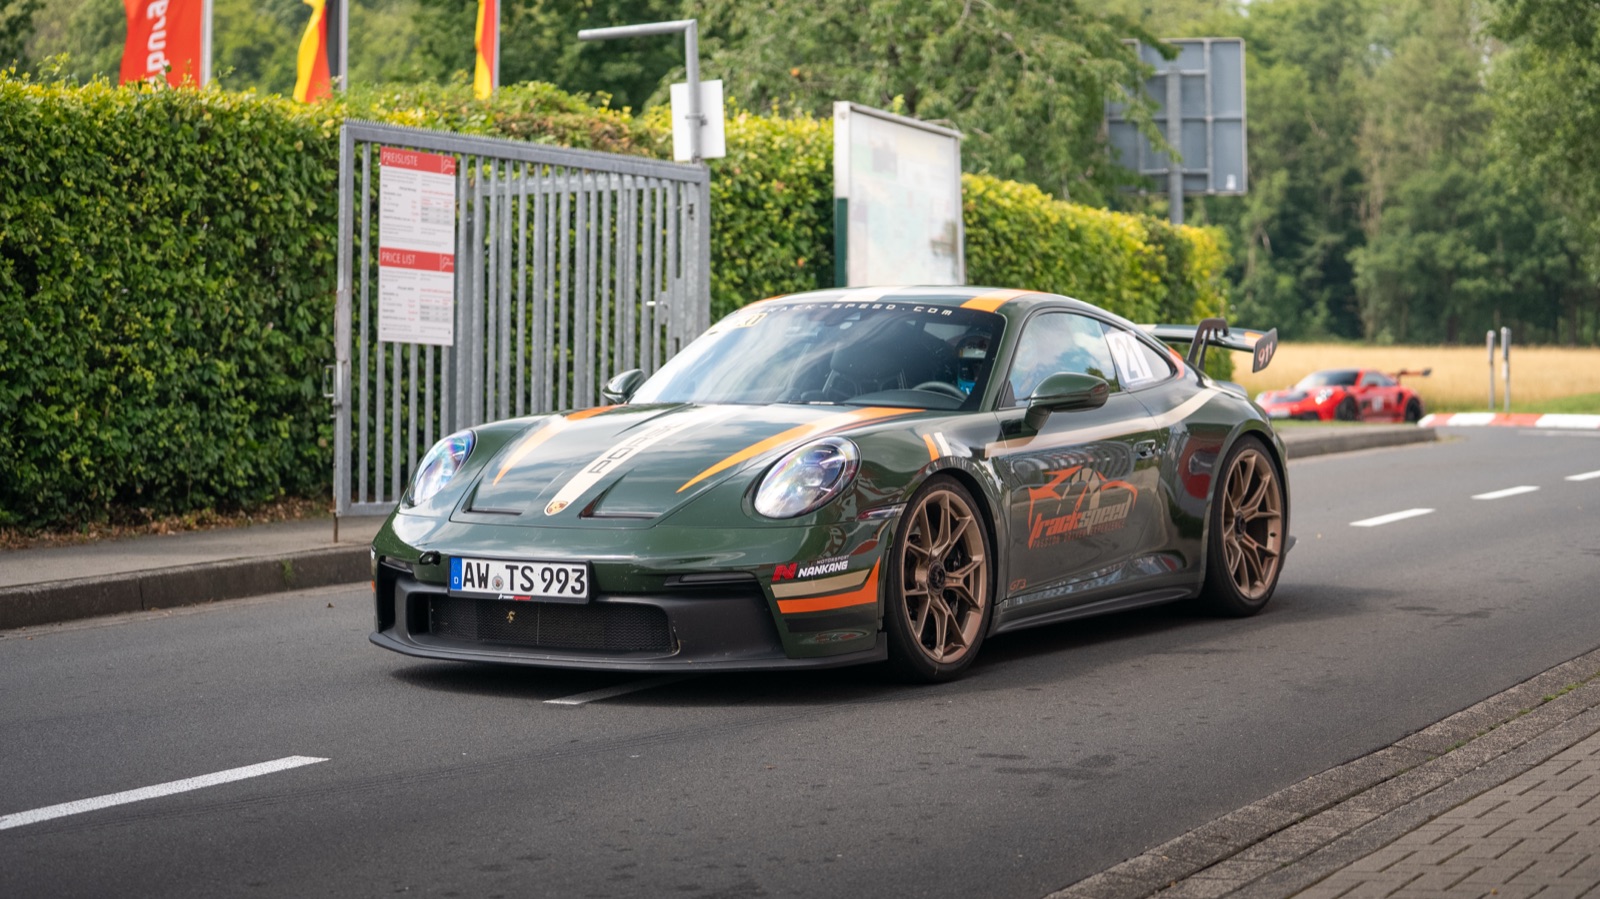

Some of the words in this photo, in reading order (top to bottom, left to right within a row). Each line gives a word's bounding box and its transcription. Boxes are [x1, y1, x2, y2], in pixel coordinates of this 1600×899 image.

[382, 151, 419, 167] PREISLISTE
[381, 251, 401, 264] PRICE
[402, 254, 417, 265] LIST
[758, 302, 953, 316] RACK-SPEED.COM
[1114, 334, 1146, 380] 21
[1257, 341, 1274, 368] 911
[816, 554, 850, 565] MOTORSPORT
[797, 560, 849, 578] NANKANG
[453, 576, 459, 584] D
[462, 561, 490, 589] AW
[505, 564, 535, 592] TS
[540, 566, 586, 595] 993
[1009, 579, 1027, 591] GT3
